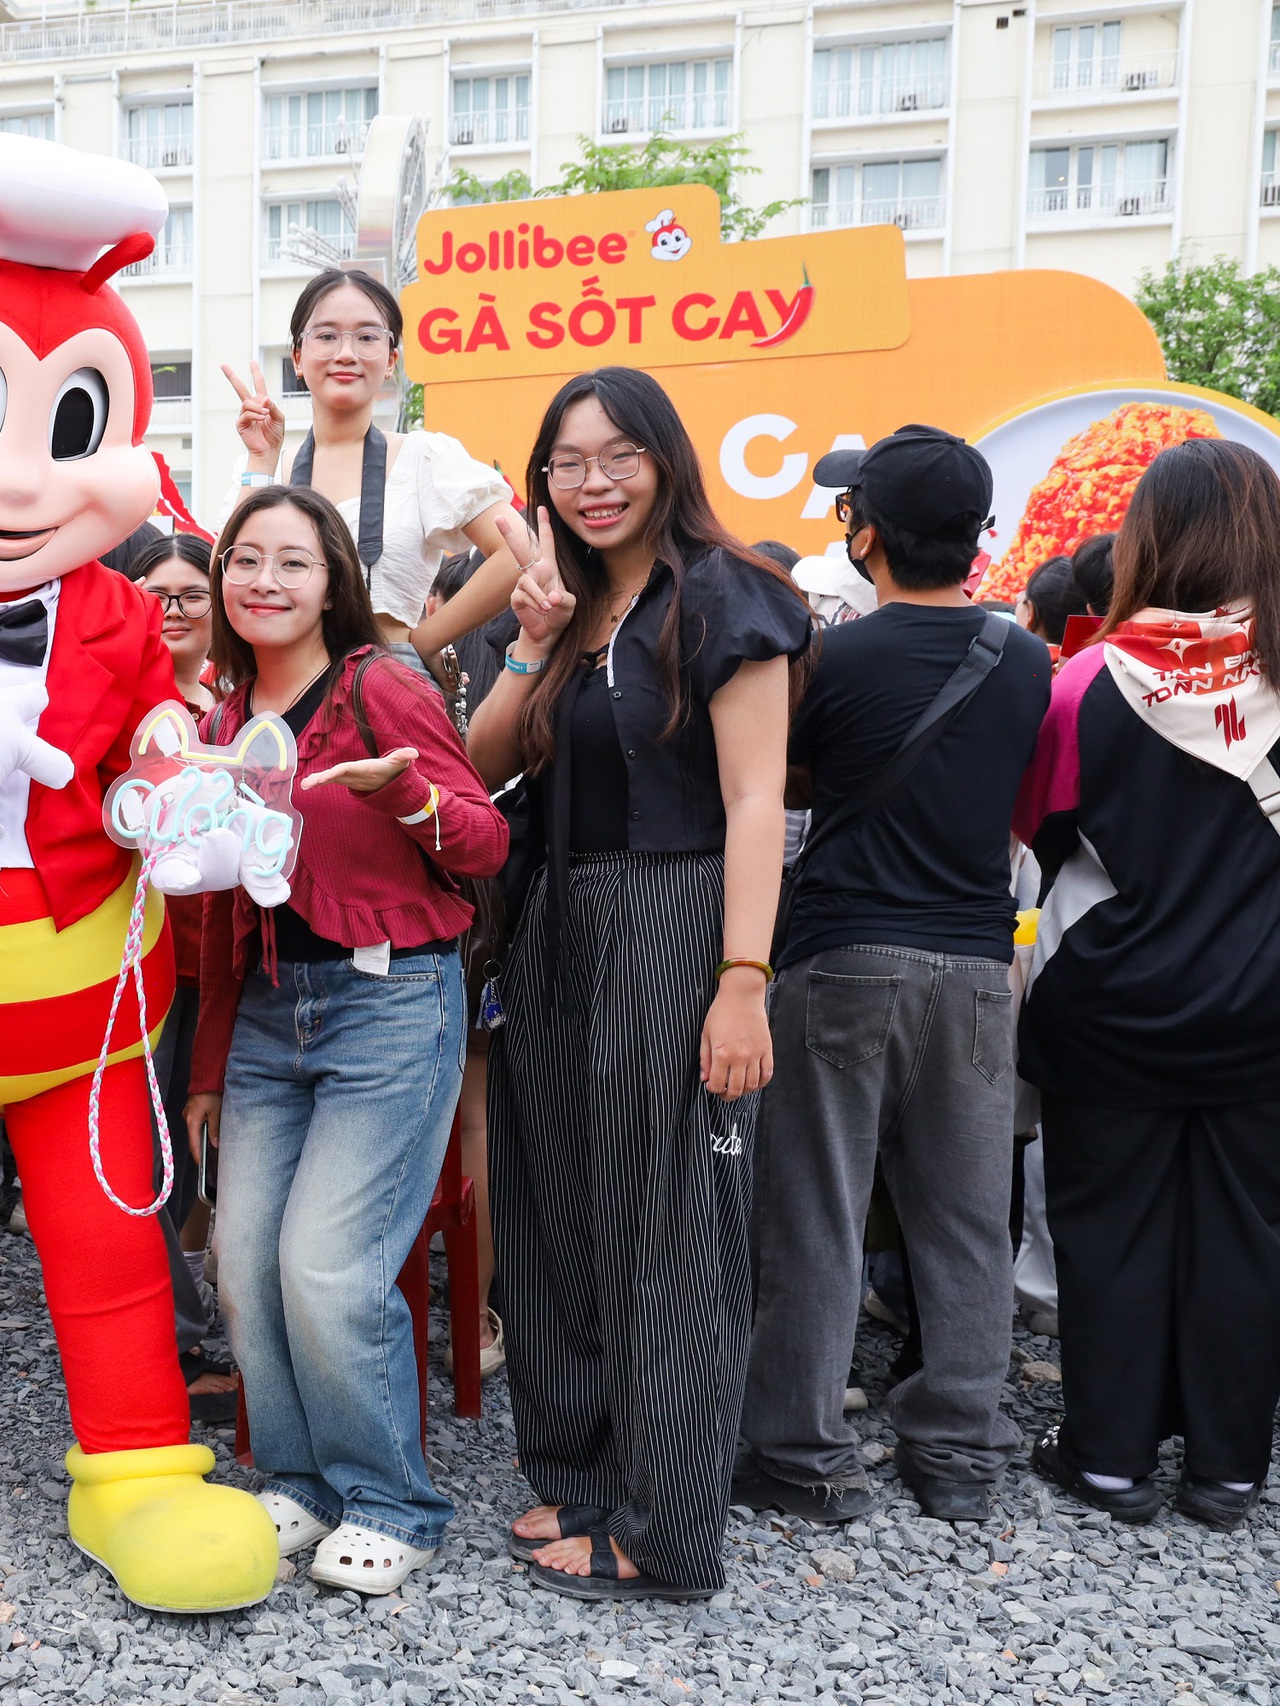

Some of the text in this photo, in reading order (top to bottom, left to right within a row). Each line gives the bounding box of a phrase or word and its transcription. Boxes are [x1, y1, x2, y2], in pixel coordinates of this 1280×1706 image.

[423, 222, 629, 275] Jollibee
[417, 275, 816, 355] GÀ SỐT CAY
[1223, 650, 1262, 670] BIN
